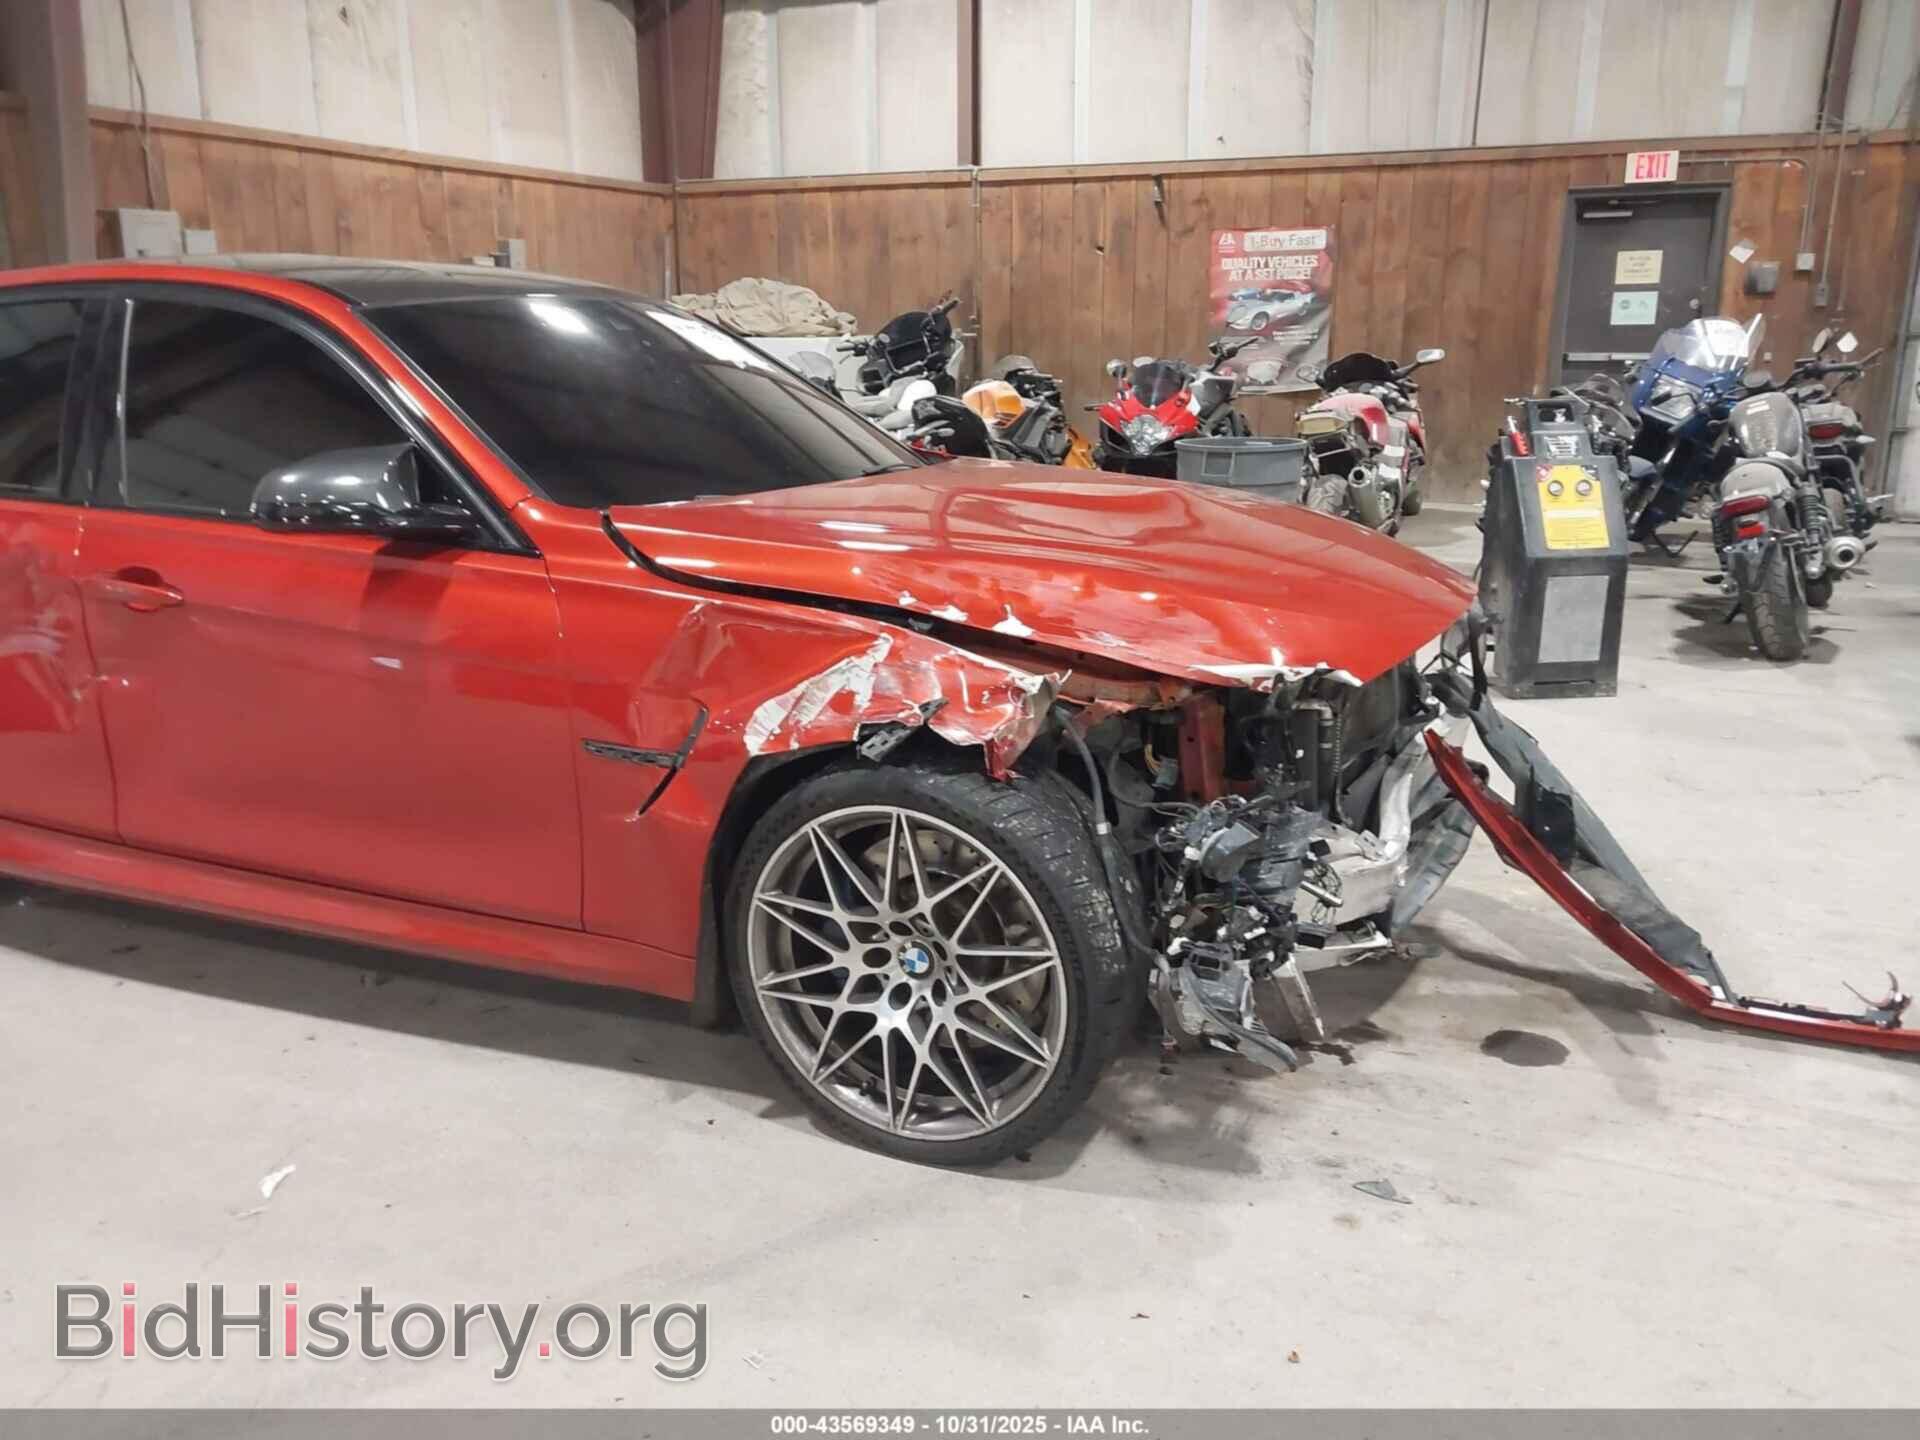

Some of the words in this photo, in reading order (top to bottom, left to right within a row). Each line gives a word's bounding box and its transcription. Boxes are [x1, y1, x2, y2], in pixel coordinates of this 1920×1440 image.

[1635, 153, 1670, 179] EXIT
[1288, 233, 1318, 247] Fast
[1222, 257, 1266, 270] QUALITY
[1267, 255, 1318, 268] VEHICLES
[1229, 269, 1243, 281] AT
[1245, 269, 1253, 280] A
[1255, 268, 1275, 280] SET
